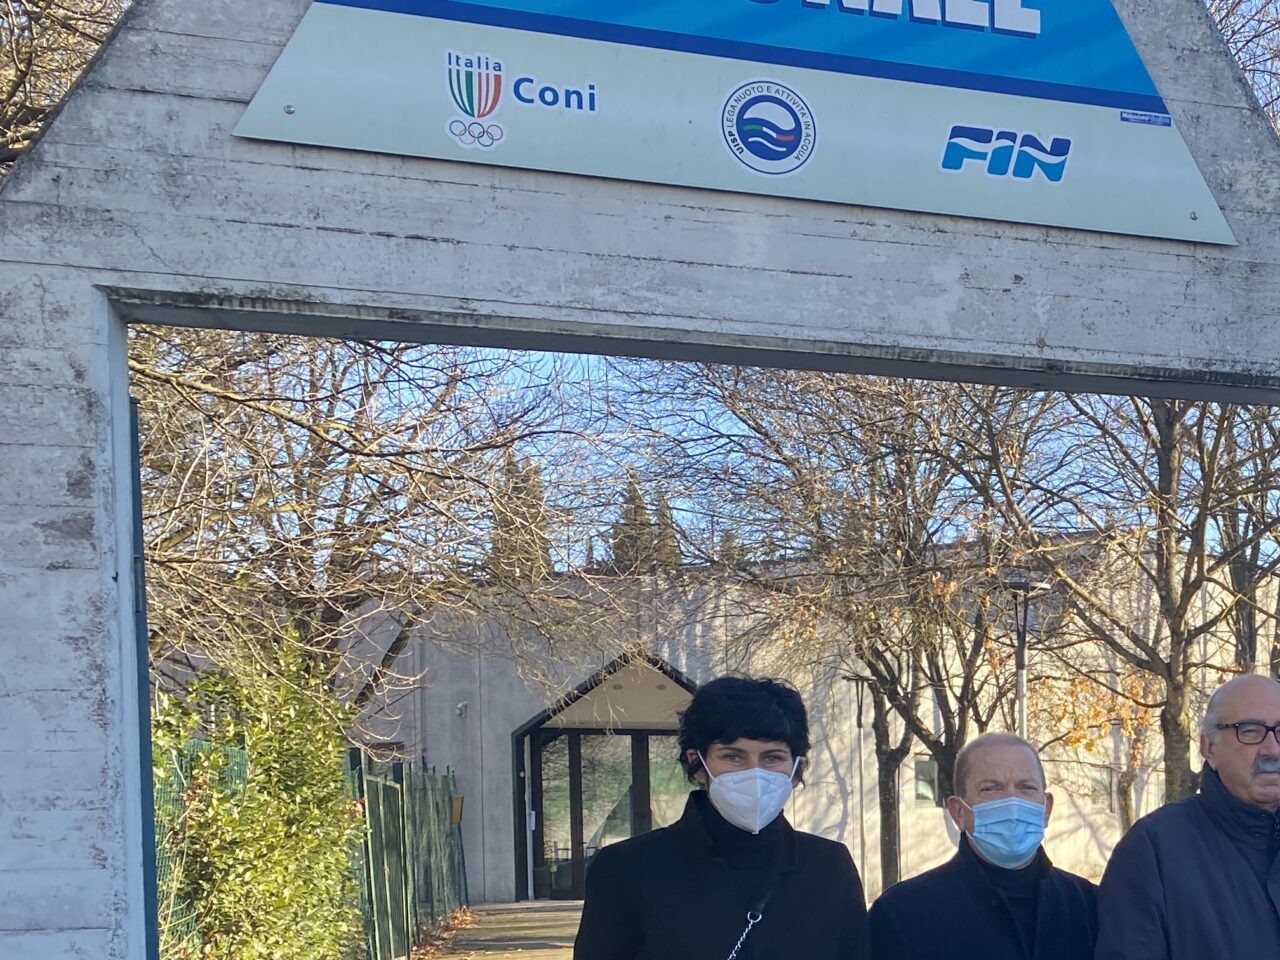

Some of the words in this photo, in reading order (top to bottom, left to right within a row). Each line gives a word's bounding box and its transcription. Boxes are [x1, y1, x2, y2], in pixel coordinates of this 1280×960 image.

[448, 52, 502, 72] Italia
[513, 77, 596, 111] Coni
[733, 85, 764, 105] NUOTO
[766, 86, 772, 94] E
[726, 104, 738, 128] LEGA
[803, 121, 811, 130] IN
[727, 130, 745, 155] UISP
[793, 133, 812, 161] ACQUA
[942, 125, 1071, 182] FIN
